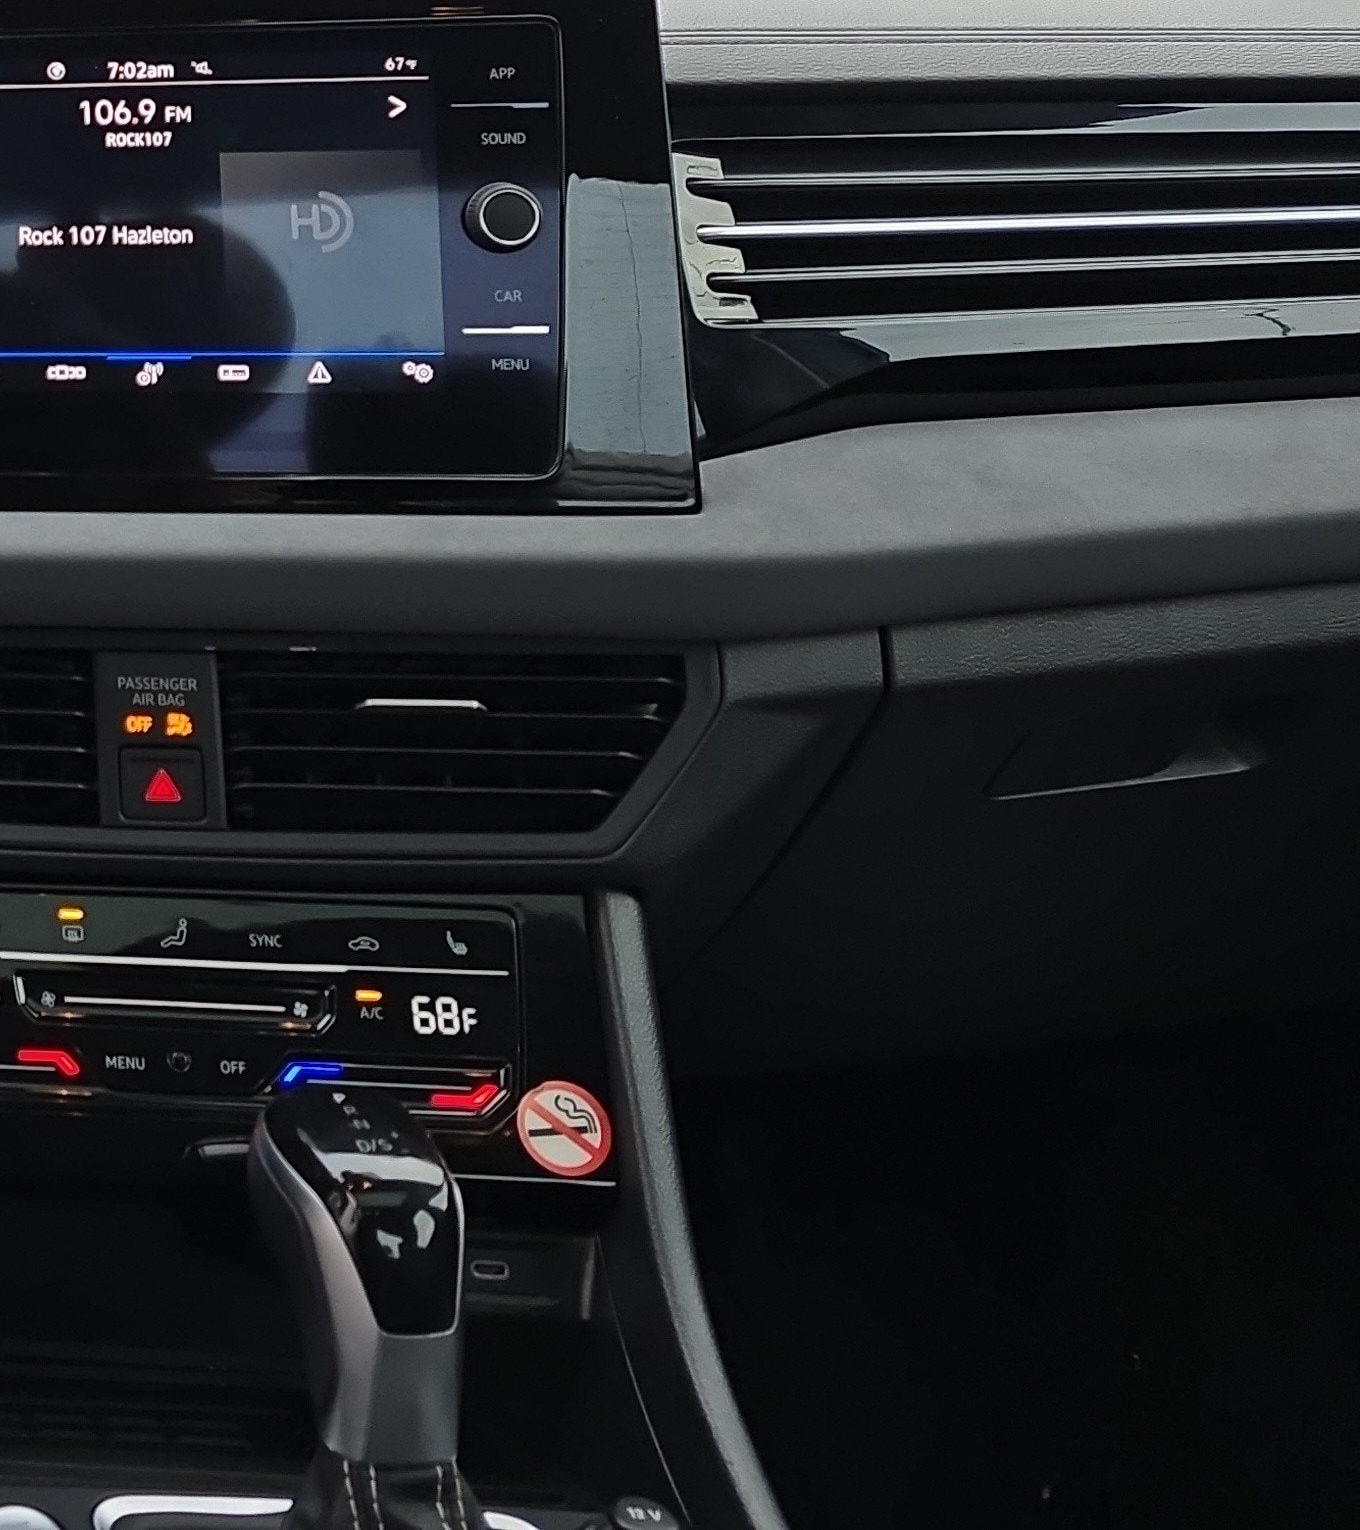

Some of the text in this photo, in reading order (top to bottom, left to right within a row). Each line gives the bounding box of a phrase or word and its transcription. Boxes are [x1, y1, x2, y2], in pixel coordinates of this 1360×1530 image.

[107, 61, 175, 80] 7:02am
[489, 66, 516, 81] APP
[78, 98, 192, 126] 106.9 FM
[104, 131, 173, 148] ROCK107
[480, 131, 527, 146] SOUND
[18, 224, 194, 247] Rock 107 Hazleton
[494, 289, 523, 303] CAR
[491, 357, 530, 372] MENU
[116, 676, 198, 692] PASSENGER
[132, 692, 186, 707] AIR BAG
[125, 715, 153, 734] OFF
[248, 933, 283, 949] SYNC
[359, 1006, 384, 1021] A/C
[104, 1055, 146, 1071] MENU
[219, 1060, 247, 1075] OFF
